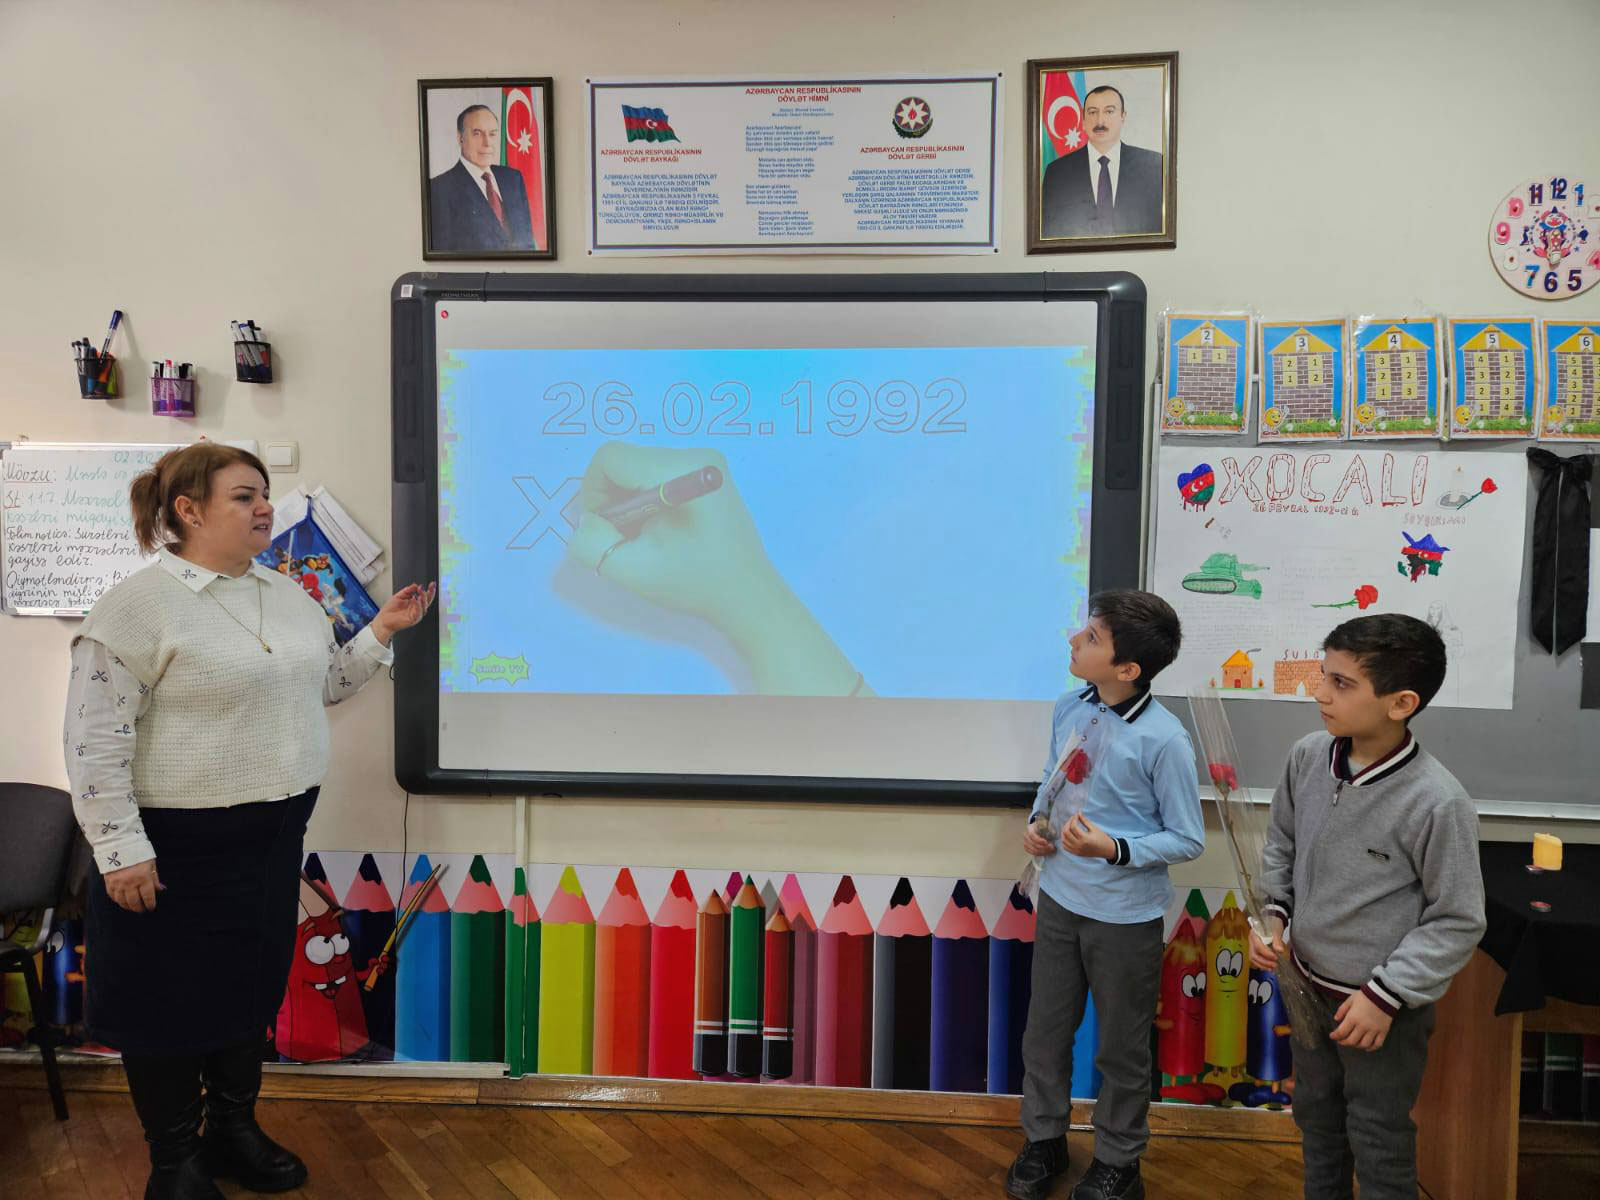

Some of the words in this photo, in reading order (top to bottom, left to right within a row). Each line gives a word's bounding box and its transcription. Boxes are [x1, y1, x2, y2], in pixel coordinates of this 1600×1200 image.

[1529, 184, 1543, 205] 11
[1551, 178, 1567, 200] 12
[1574, 184, 1584, 206] 1
[1496, 222, 1511, 243] 9
[1524, 265, 1540, 287] 7
[1544, 272, 1558, 292] 6
[1568, 269, 1582, 291] 5
[1204, 331, 1210, 340] 2
[1299, 337, 1305, 347] 3
[1390, 335, 1397, 344] 4
[1489, 333, 1496, 343] 5
[1583, 336, 1590, 346] 6
[1504, 355, 1509, 363] 1
[1479, 371, 1485, 379] 3
[1479, 387, 1485, 395] 2
[1505, 387, 1510, 395] 3
[1572, 381, 1577, 389] 3
[541, 377, 968, 437] 26.02.1992
[1219, 453, 1428, 506] XOCALI
